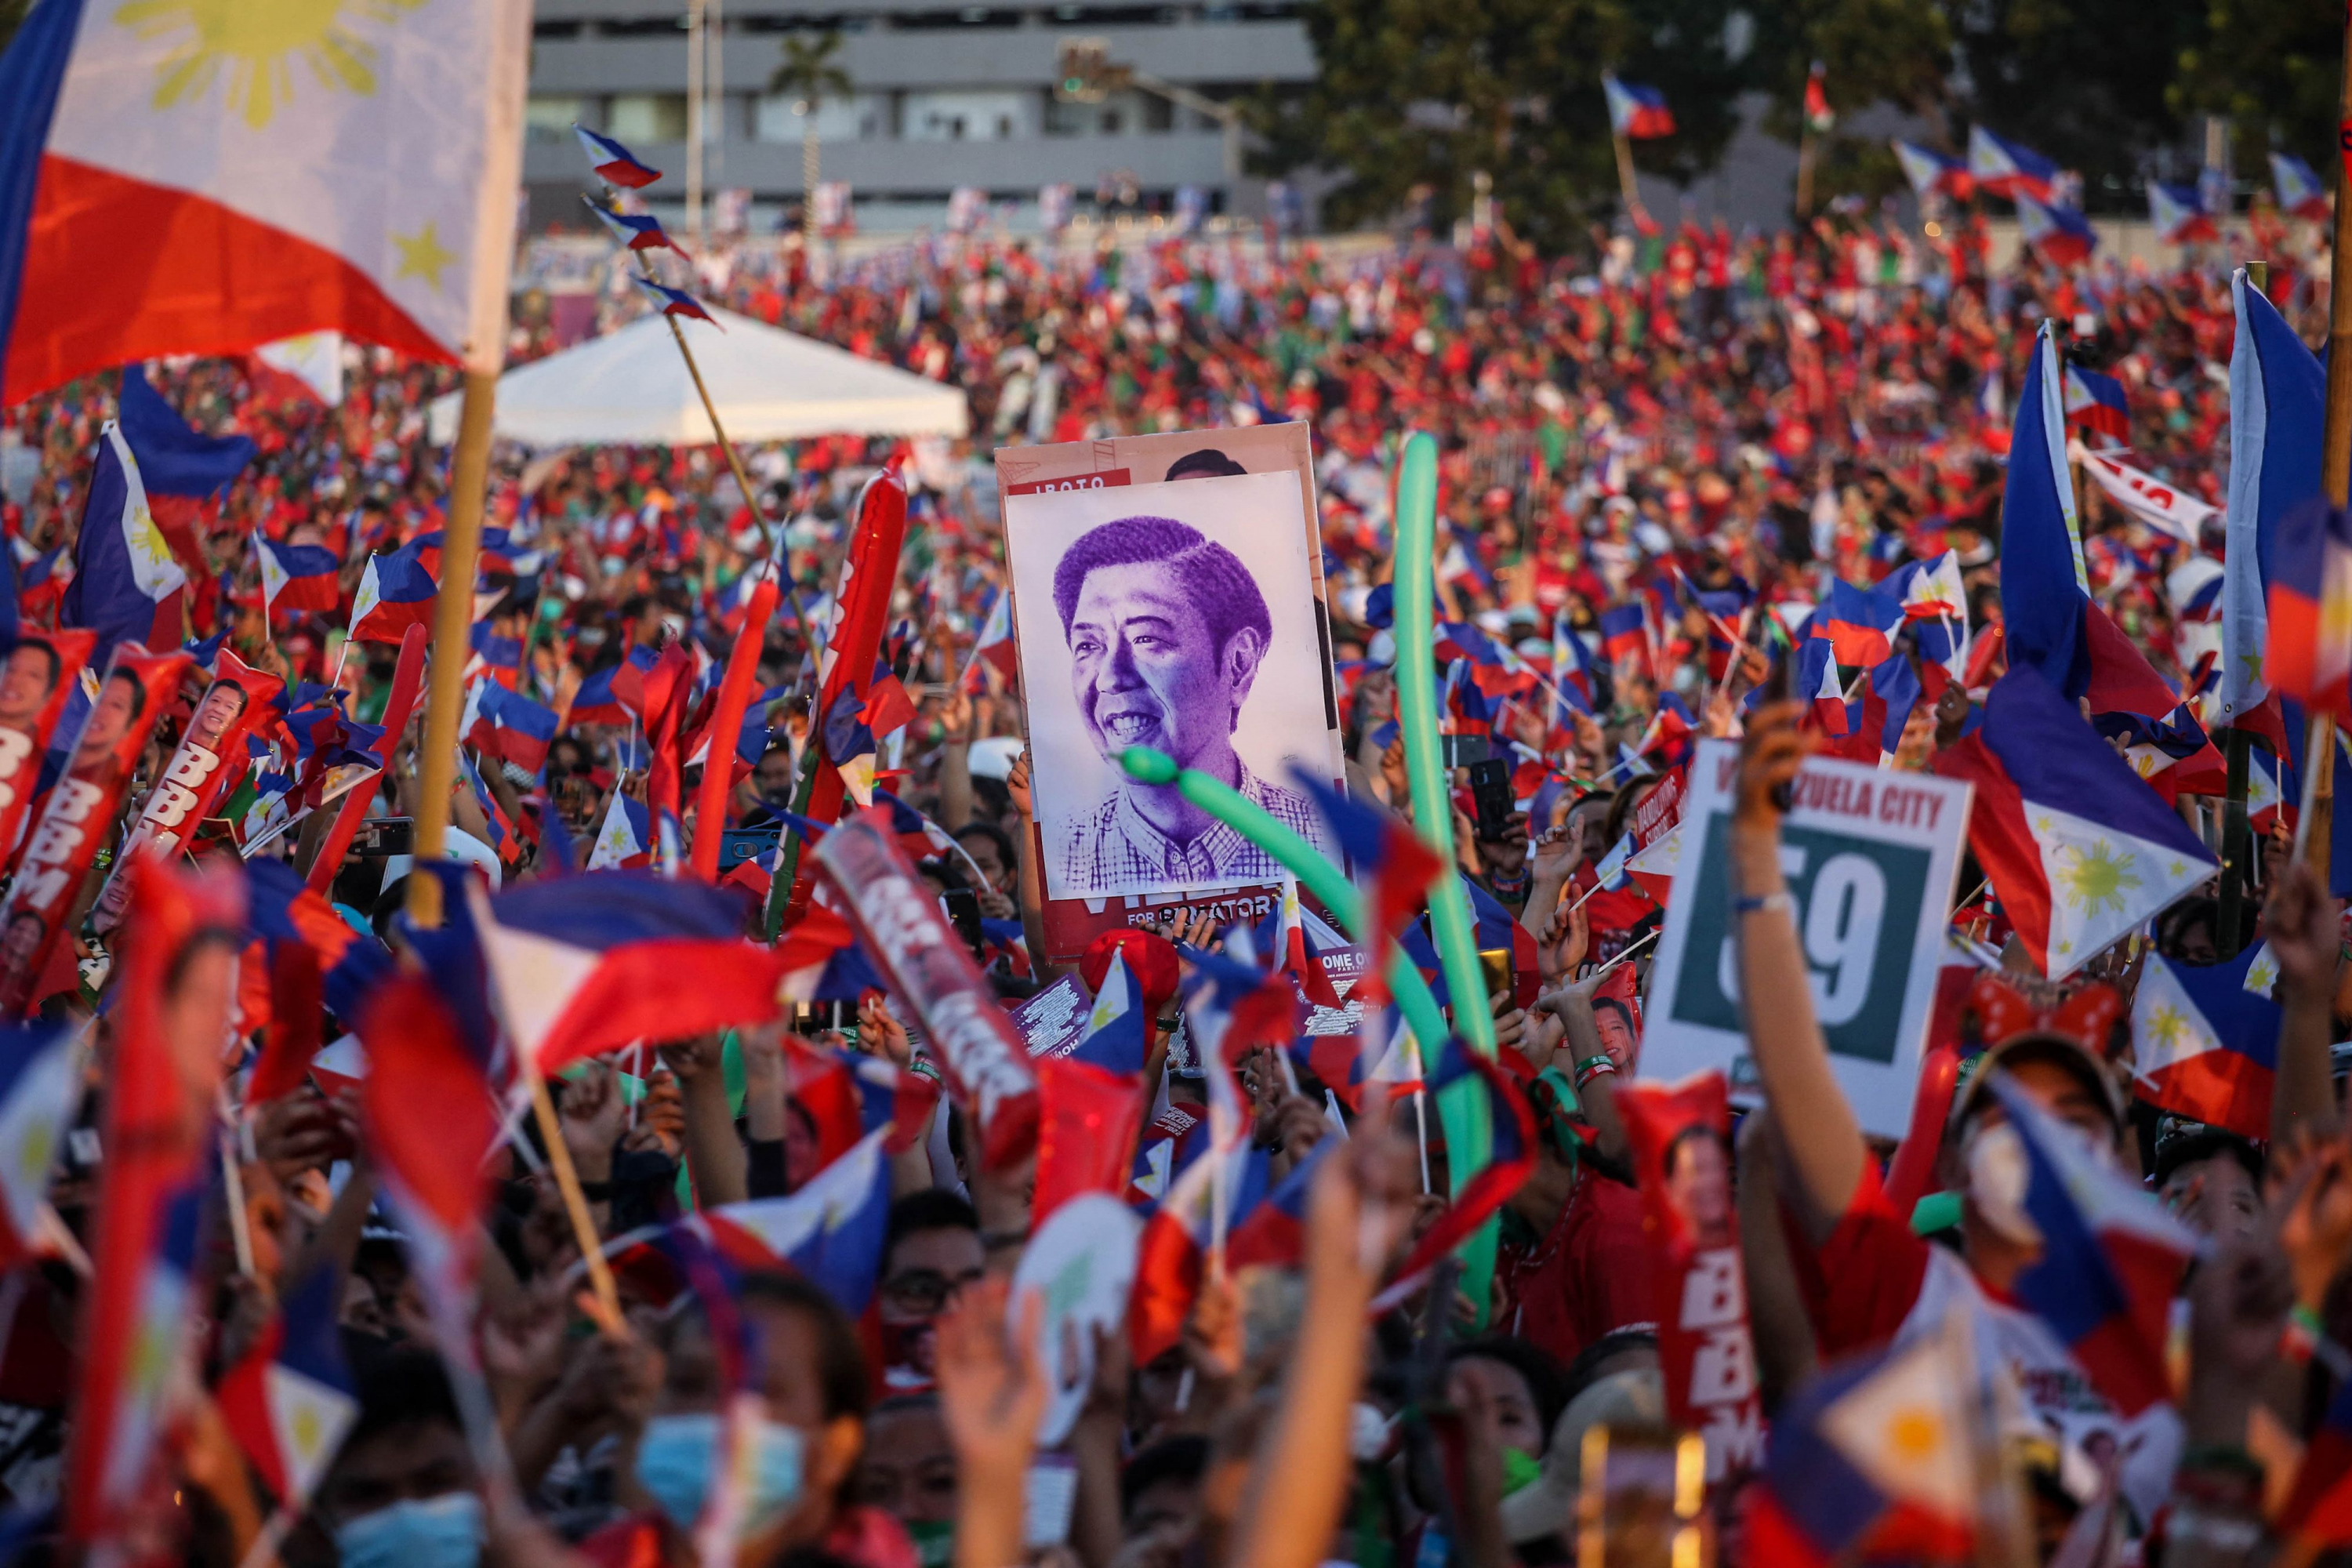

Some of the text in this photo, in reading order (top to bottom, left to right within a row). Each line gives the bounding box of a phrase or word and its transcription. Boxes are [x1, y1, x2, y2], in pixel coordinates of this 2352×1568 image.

[1715, 757, 1874, 818] VZUELA
[1878, 786, 1945, 829] CITY
[13, 776, 103, 910] BBM
[1127, 912, 1155, 926] FOR
[1159, 895, 1271, 925] SNATOR
[1322, 953, 1352, 969] OME
